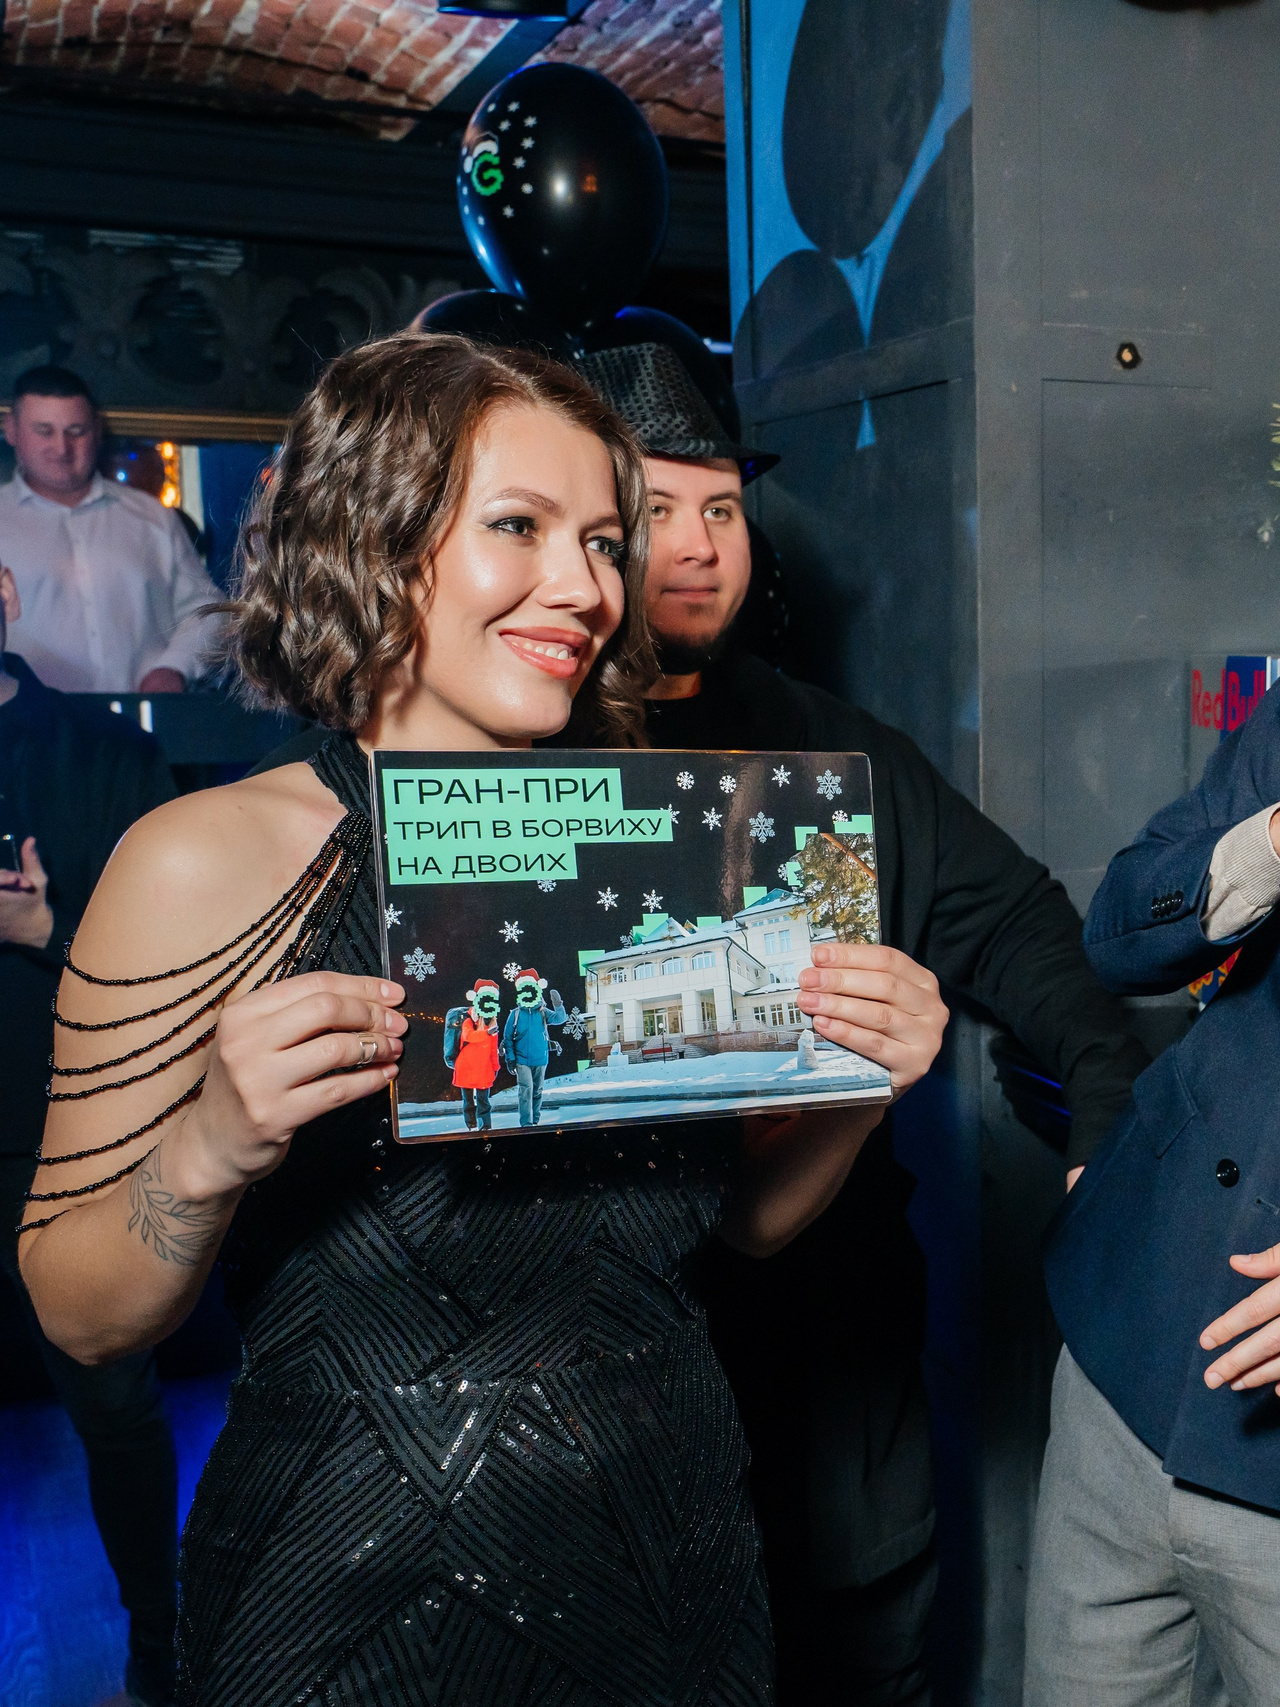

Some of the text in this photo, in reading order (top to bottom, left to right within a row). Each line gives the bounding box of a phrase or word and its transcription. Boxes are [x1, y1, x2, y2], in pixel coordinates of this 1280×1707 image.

[393, 777, 610, 805] ГРАН-ПРИ
[393, 816, 663, 841] ТРИП В БОРВИХУ
[397, 852, 569, 879] НА ДВОИХ
